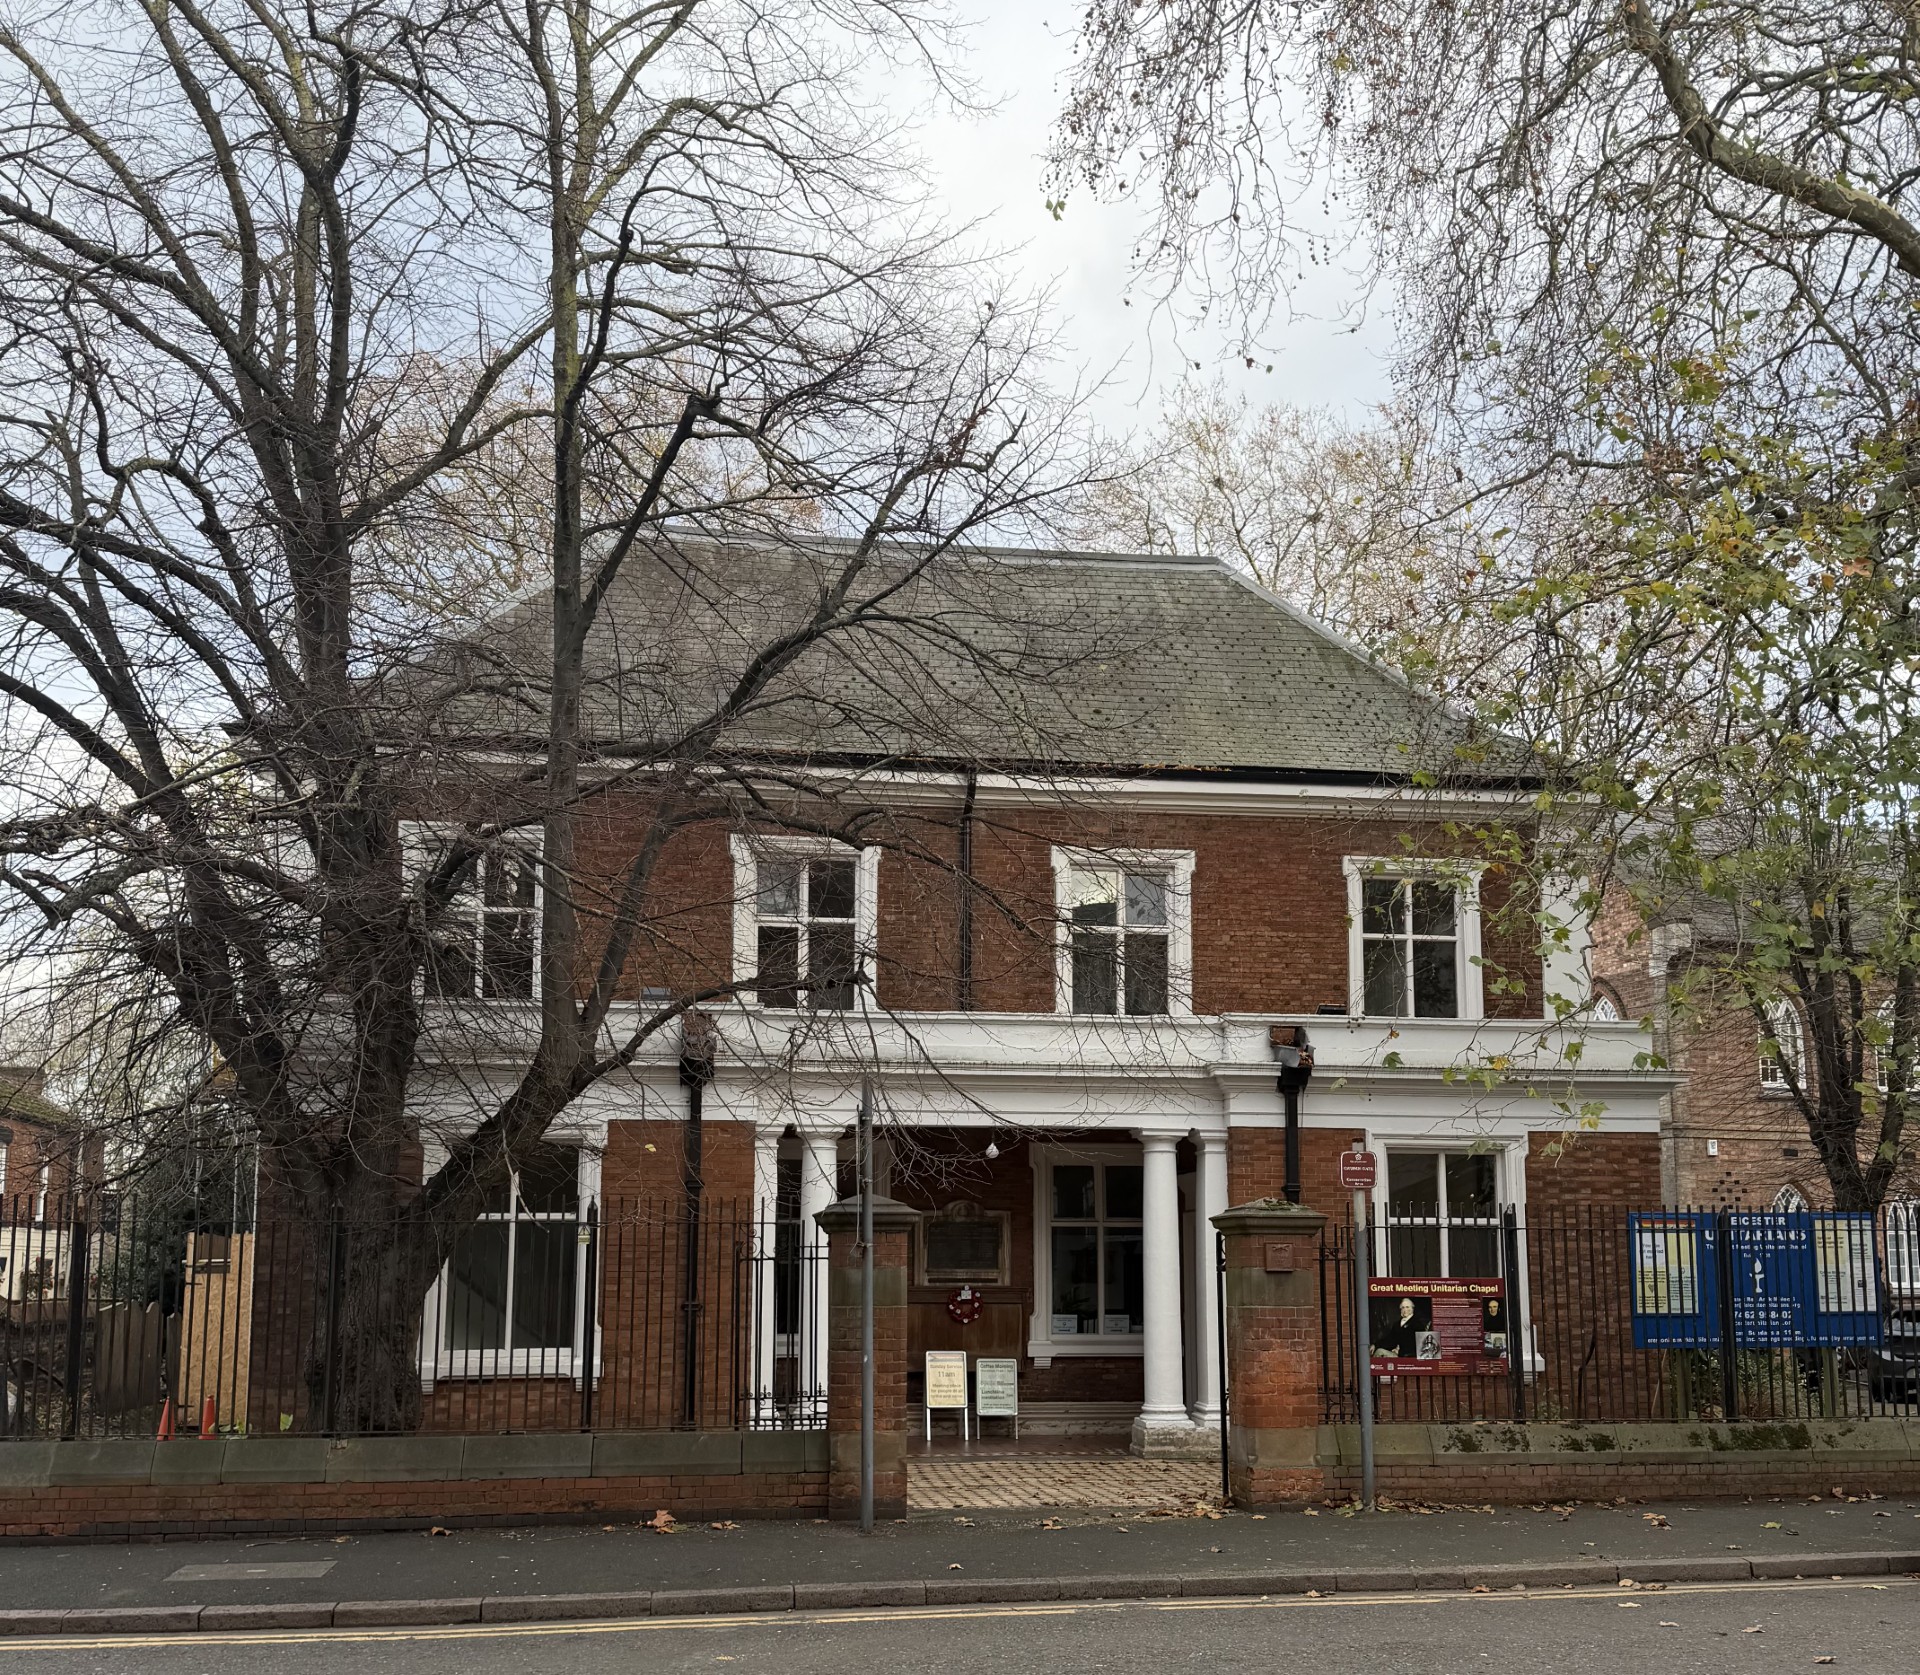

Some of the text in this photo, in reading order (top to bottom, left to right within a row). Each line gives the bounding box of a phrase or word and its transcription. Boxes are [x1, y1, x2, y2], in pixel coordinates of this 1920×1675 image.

[1370, 1283, 1499, 1294] Great Meeting Unitarian Chapel
